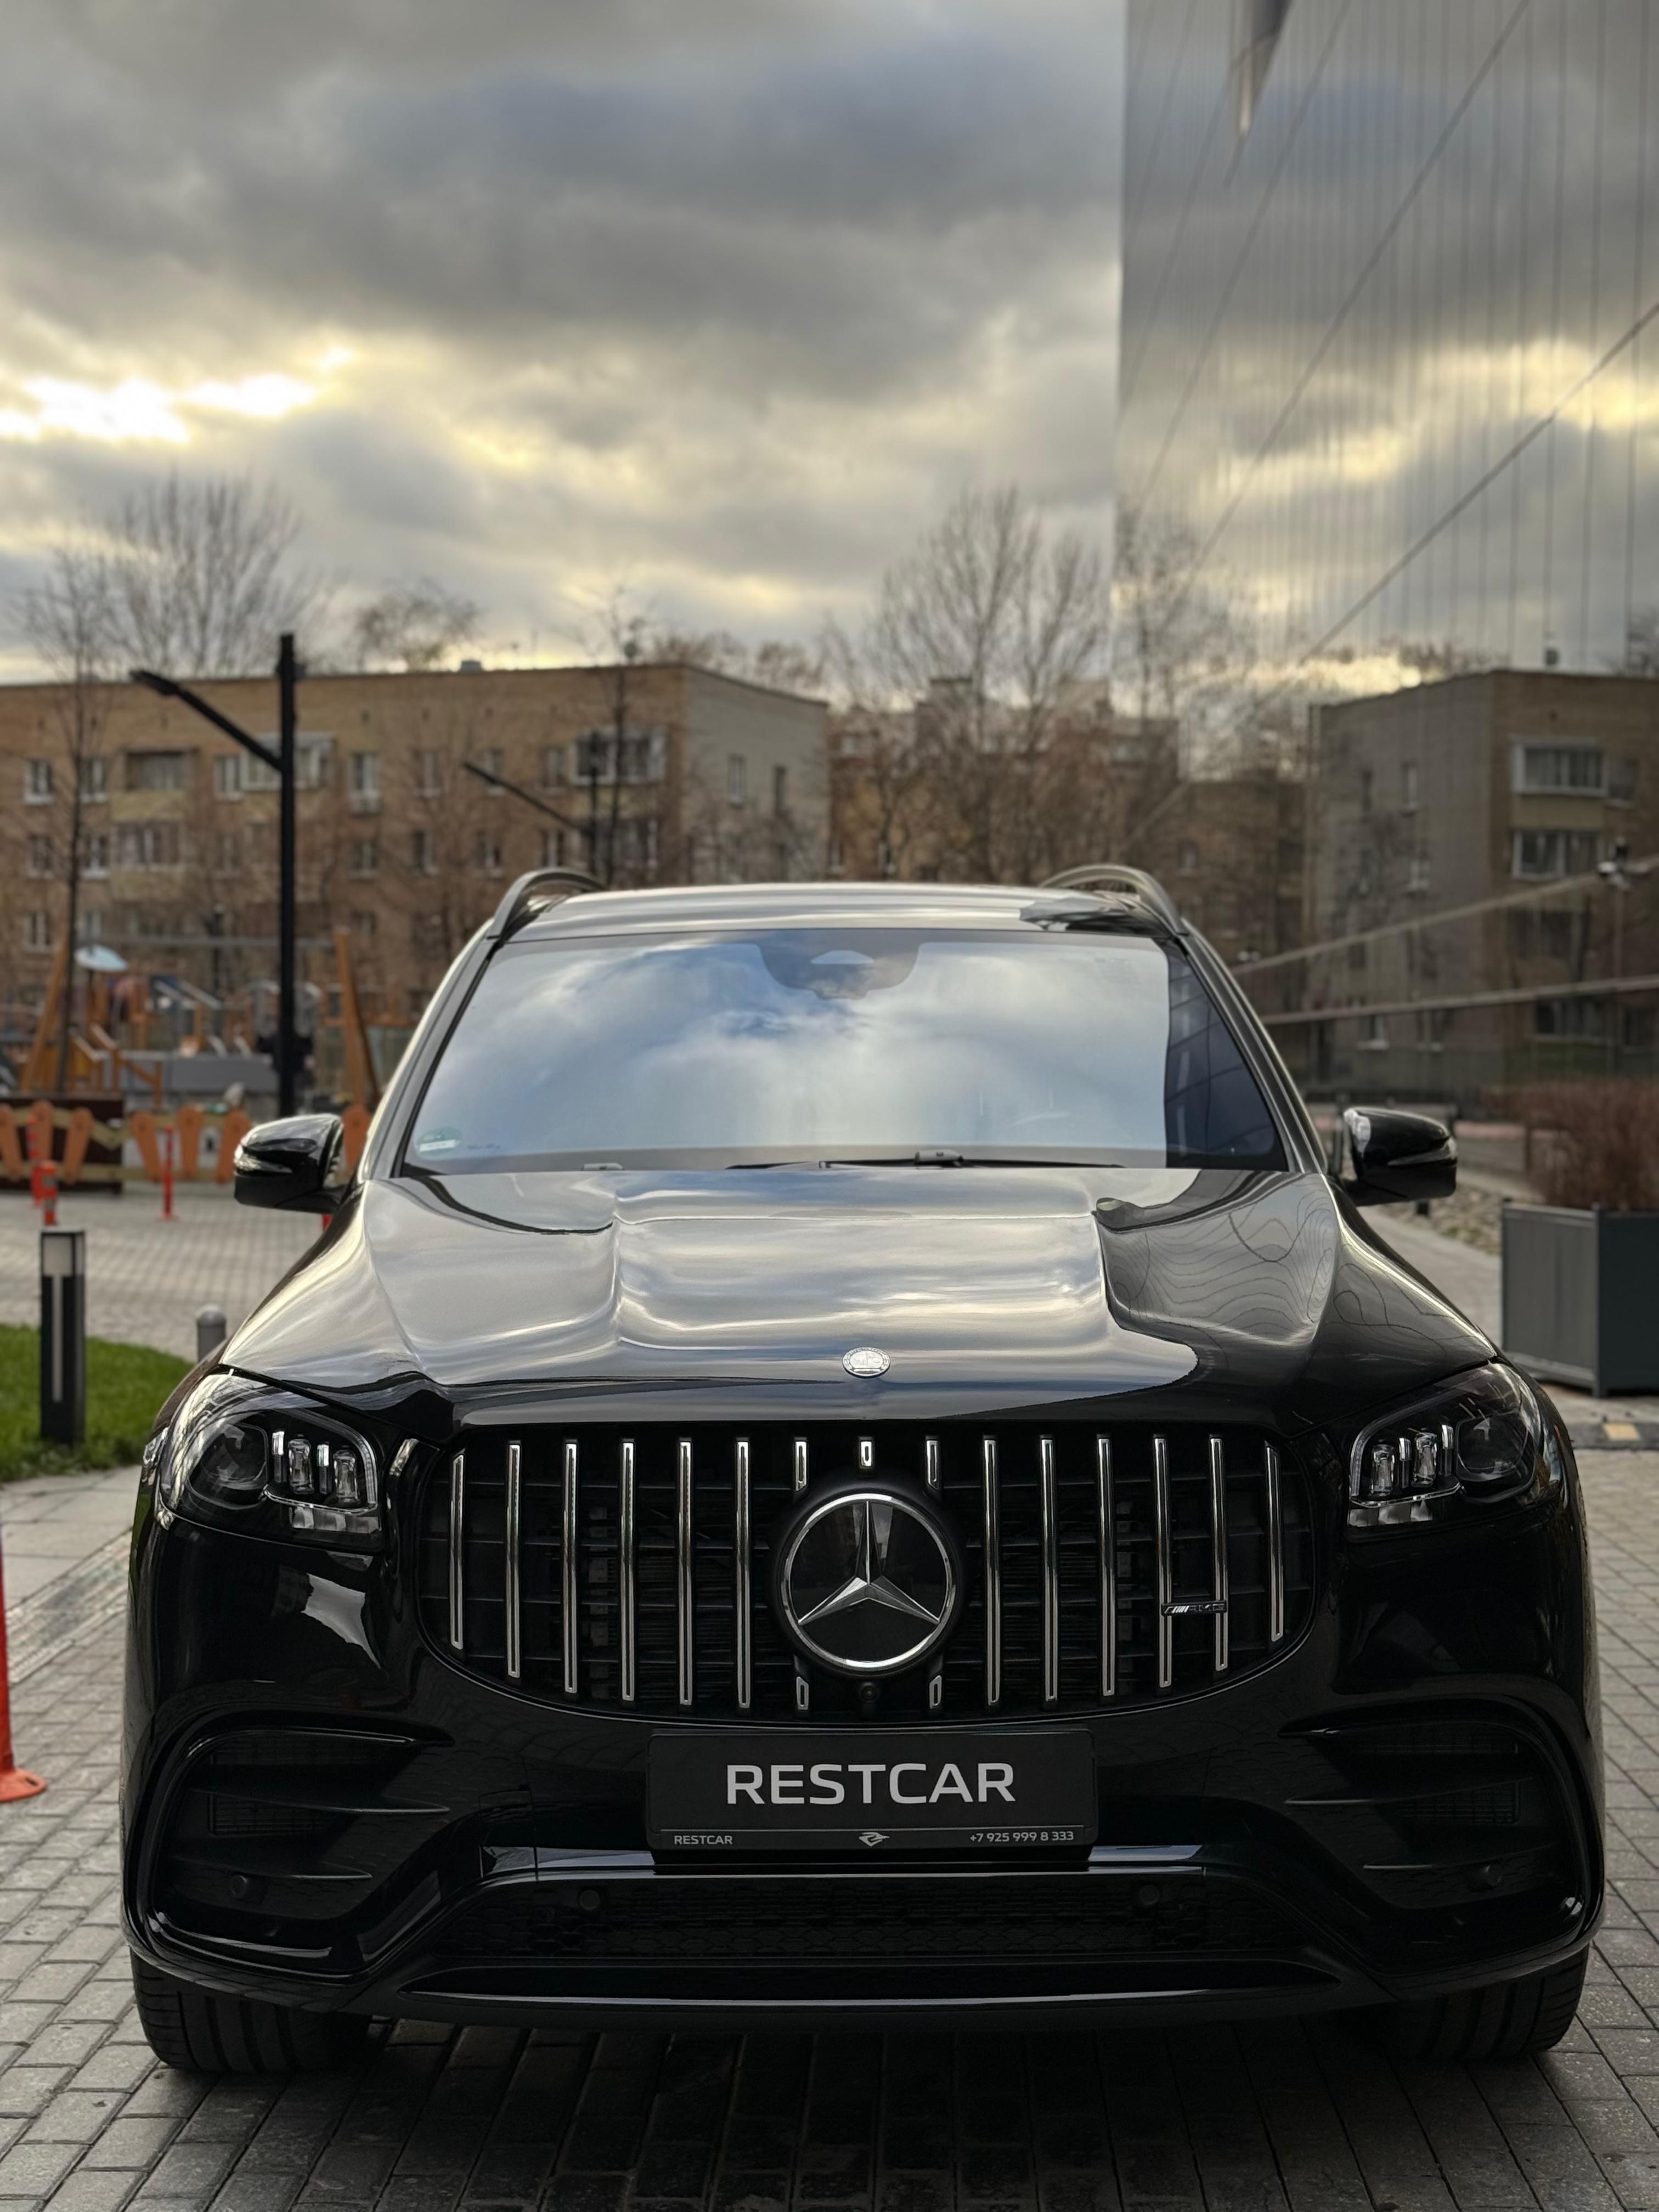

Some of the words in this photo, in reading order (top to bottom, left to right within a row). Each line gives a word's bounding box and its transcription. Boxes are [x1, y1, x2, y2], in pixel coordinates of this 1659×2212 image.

[727, 1763, 1016, 1804] RESTCAR
[674, 1835, 733, 1844] RESTCAR
[970, 1833, 984, 1842] +7
[986, 1832, 1009, 1842] 925
[1012, 1832, 1037, 1841] 999
[1040, 1831, 1048, 1841] 8
[1051, 1831, 1074, 1841] 333
